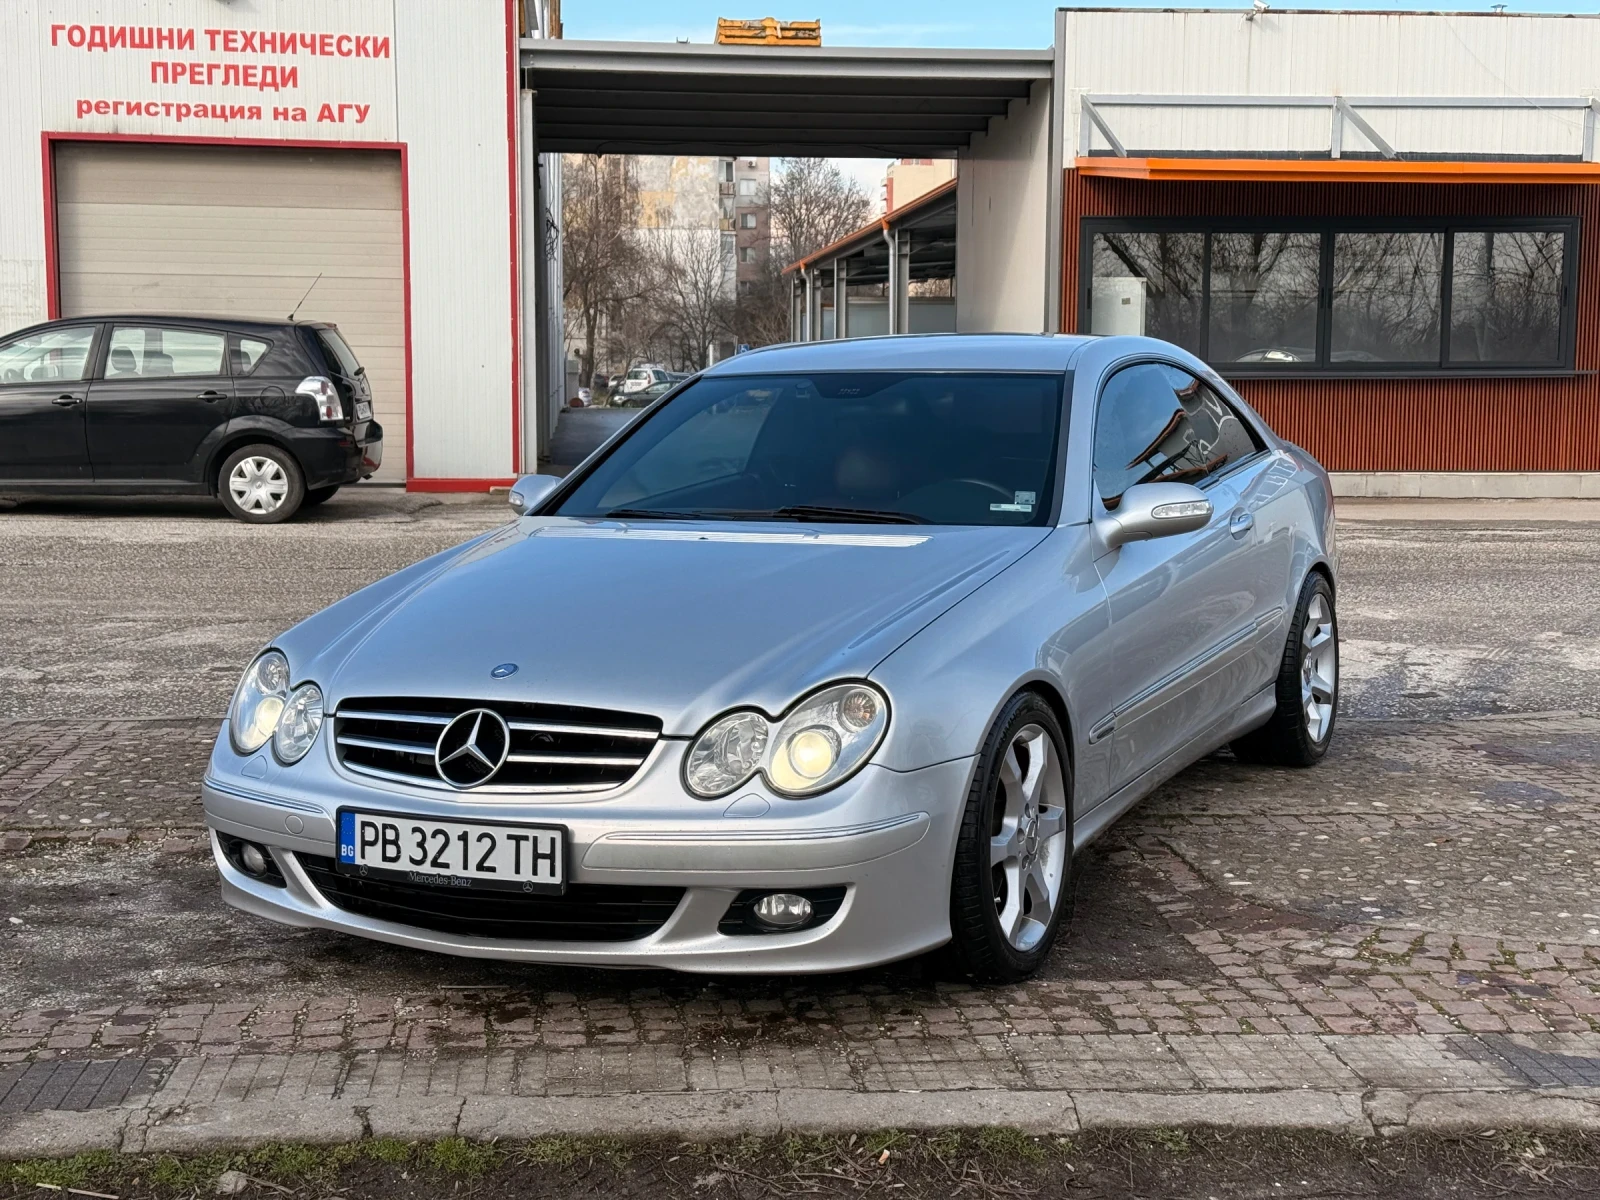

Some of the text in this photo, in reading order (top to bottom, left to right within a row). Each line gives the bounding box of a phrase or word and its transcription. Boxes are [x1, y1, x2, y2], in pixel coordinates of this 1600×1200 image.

[50, 23, 391, 59] ГОДИШНИ ТЕХНИЧЕСКИ
[150, 60, 299, 92] ПРЕГЛЕДИ
[76, 98, 371, 125] регистрация на АГУ
[341, 844, 354, 857] BG
[360, 820, 556, 877] PB 3212 TH
[407, 871, 472, 888] Mercedes-Benz
